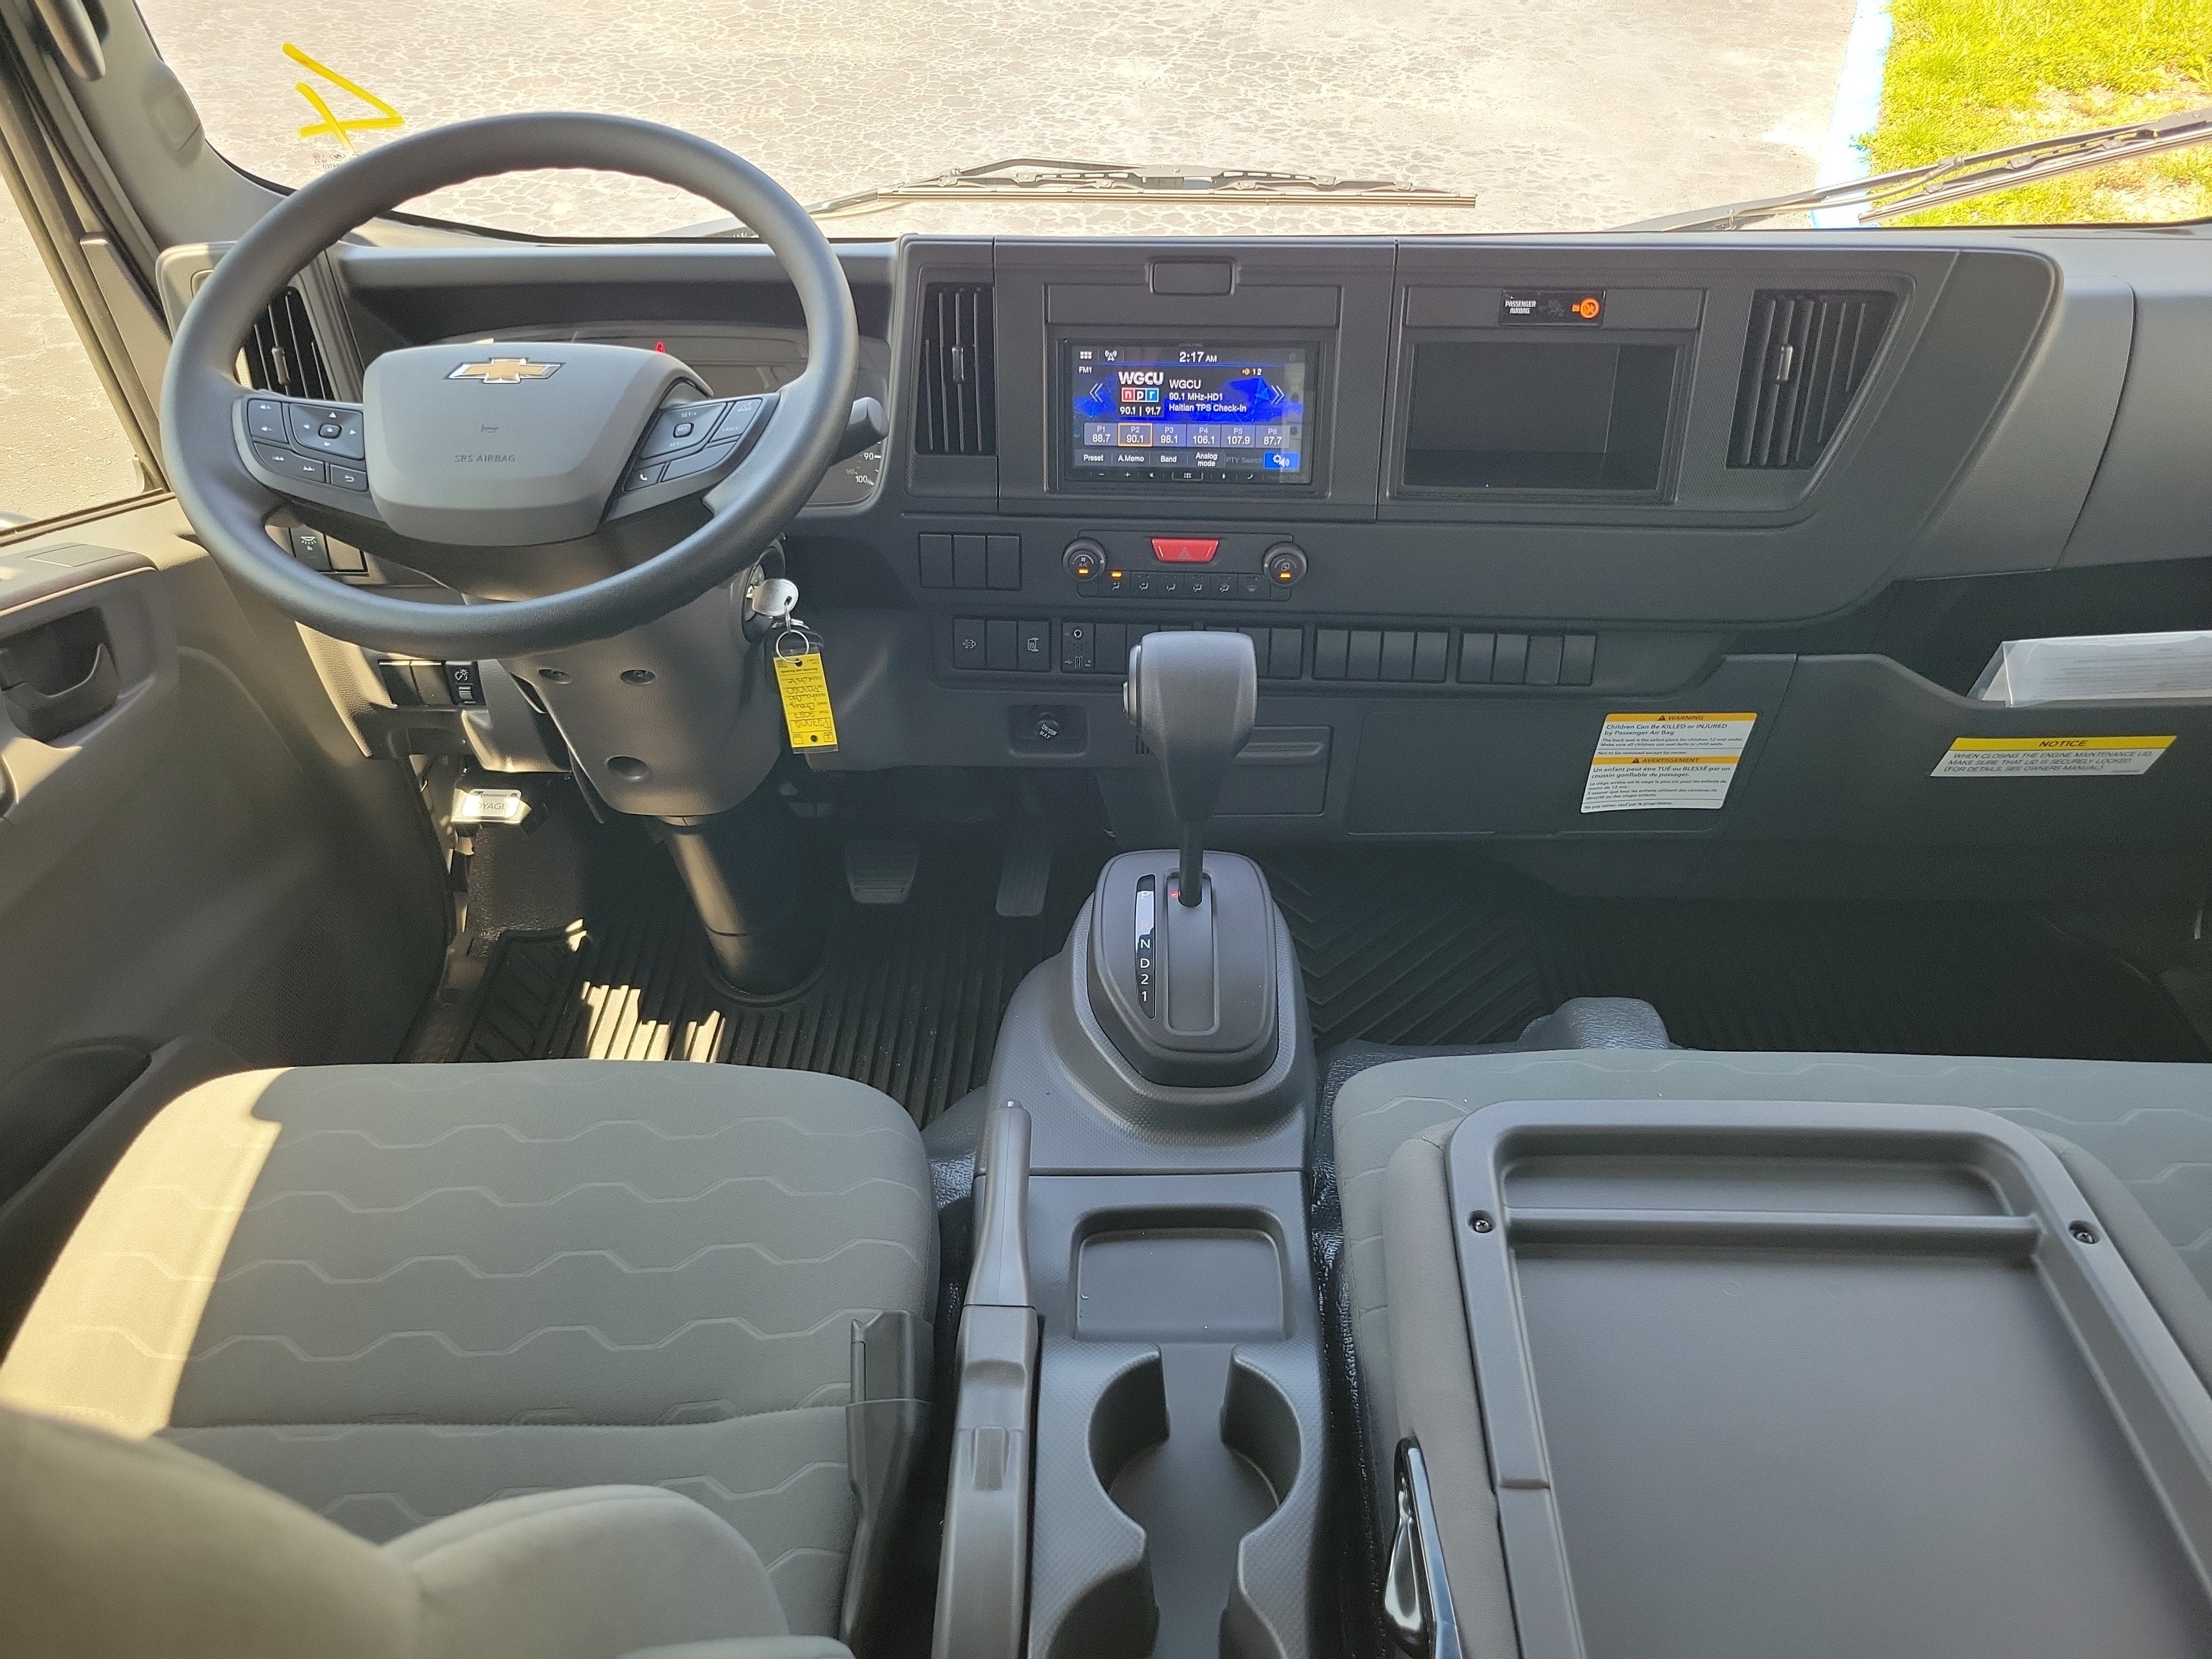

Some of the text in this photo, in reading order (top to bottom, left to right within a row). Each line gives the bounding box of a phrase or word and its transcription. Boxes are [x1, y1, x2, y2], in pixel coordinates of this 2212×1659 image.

[1180, 351, 1204, 363] 2:17
[1118, 371, 1164, 385] WGCU
[1169, 380, 1201, 389] WGCU
[1124, 389, 1157, 402] npr
[1169, 392, 1223, 401] 90.1 MHz-HD1
[1120, 407, 1161, 415] 90.1 91.7
[1213, 404, 1246, 412] Check-In
[1092, 435, 1111, 443] 88.7
[1126, 435, 1144, 443] 90.1
[1160, 435, 1178, 444] 98.1
[1193, 436, 1215, 444] 106.1
[1227, 436, 1250, 445] 107.9
[1263, 437, 1282, 445] 87.7
[1195, 452, 1217, 460] Analog
[1141, 891, 1150, 900] P
[1141, 939, 1150, 949] N
[1141, 958, 1150, 968] D
[1141, 974, 1149, 984] 2
[1141, 991, 1147, 1002] 1
